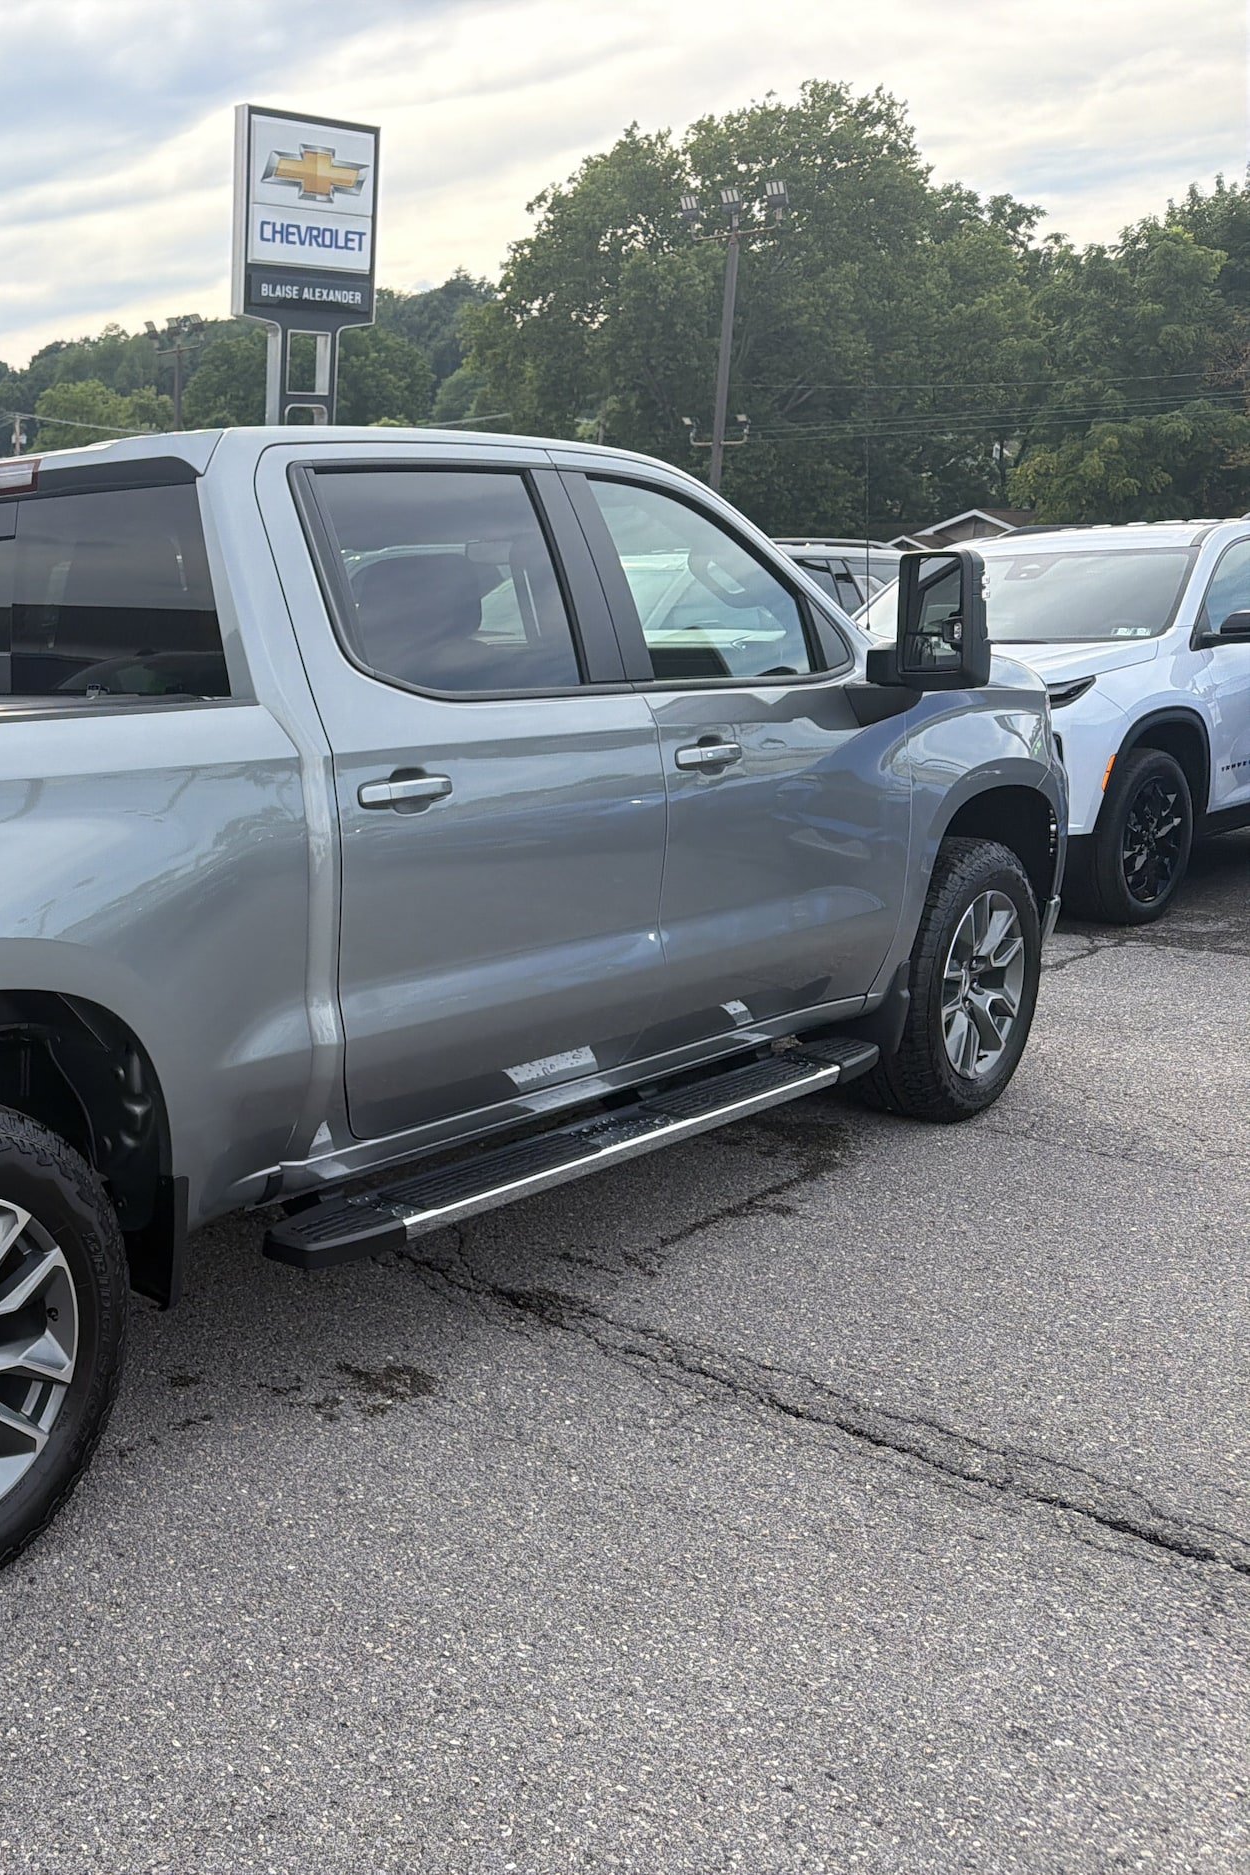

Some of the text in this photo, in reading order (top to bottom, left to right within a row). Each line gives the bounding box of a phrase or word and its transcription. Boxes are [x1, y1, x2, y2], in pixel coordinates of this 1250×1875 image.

[259, 221, 366, 252] CHEVROLET
[261, 283, 362, 305] BLAISE ALEXANDER
